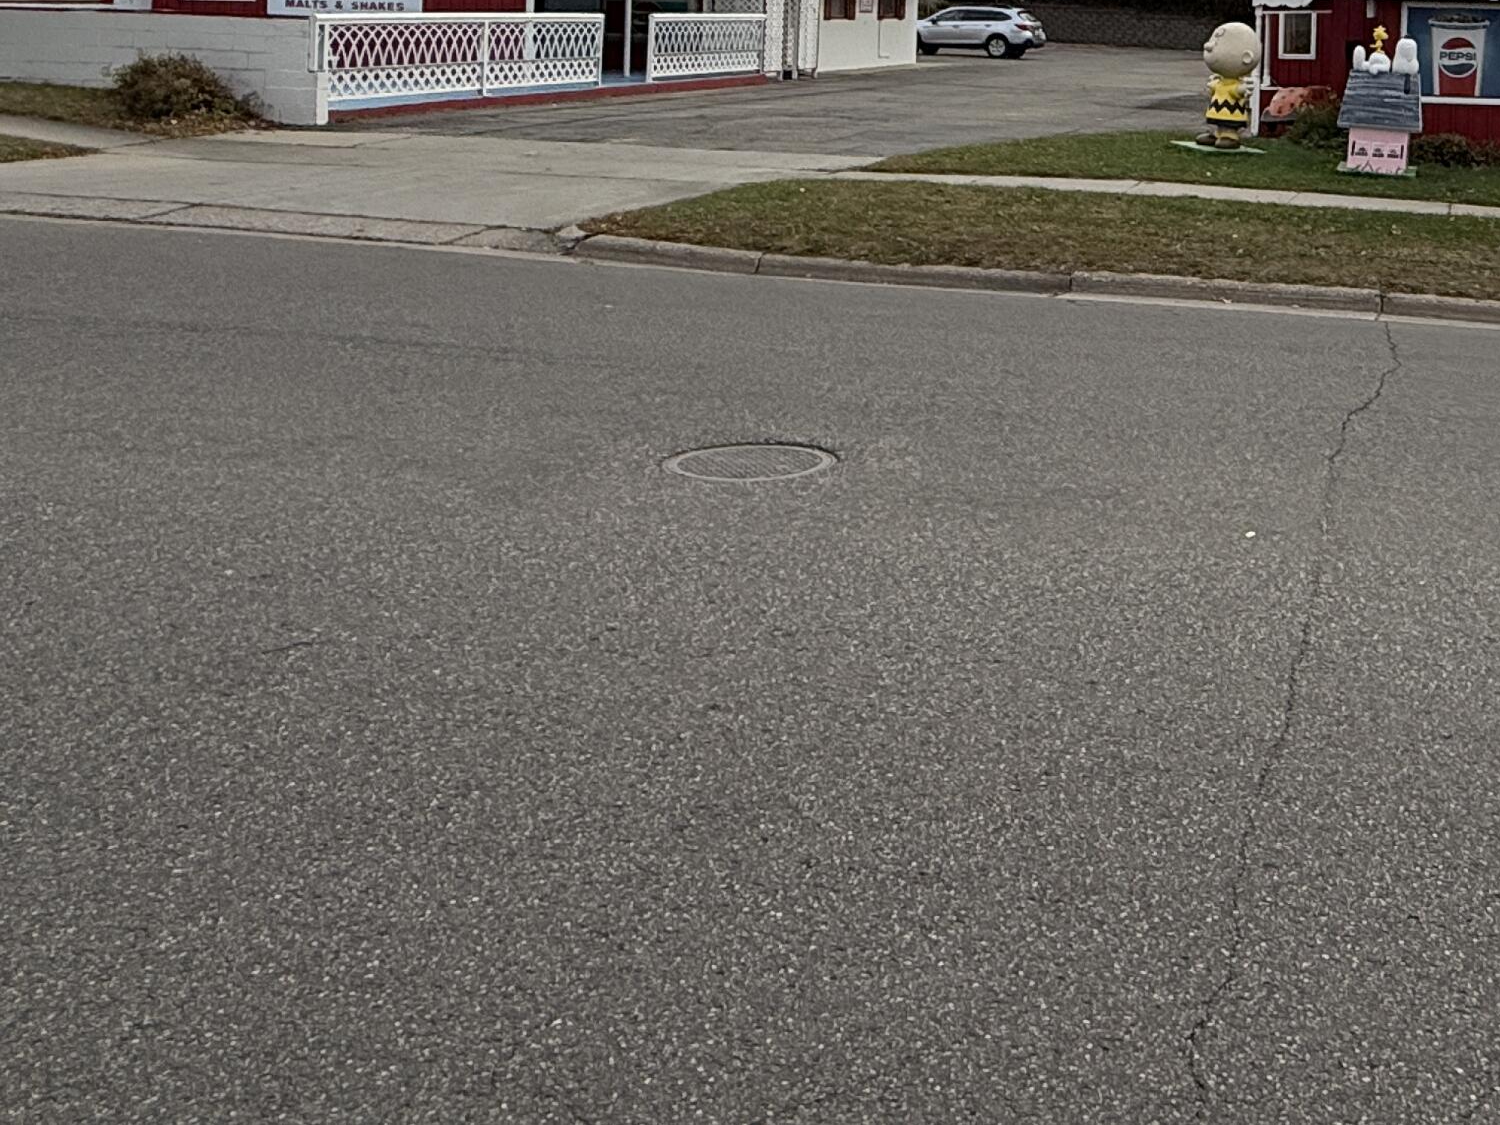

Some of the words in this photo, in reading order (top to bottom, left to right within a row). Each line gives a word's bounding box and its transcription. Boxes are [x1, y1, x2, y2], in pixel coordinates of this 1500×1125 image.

[285, 0, 329, 10] MALTS
[334, 0, 344, 10] &
[351, 1, 405, 12] SHAKES
[1439, 51, 1477, 61] PEPSI
